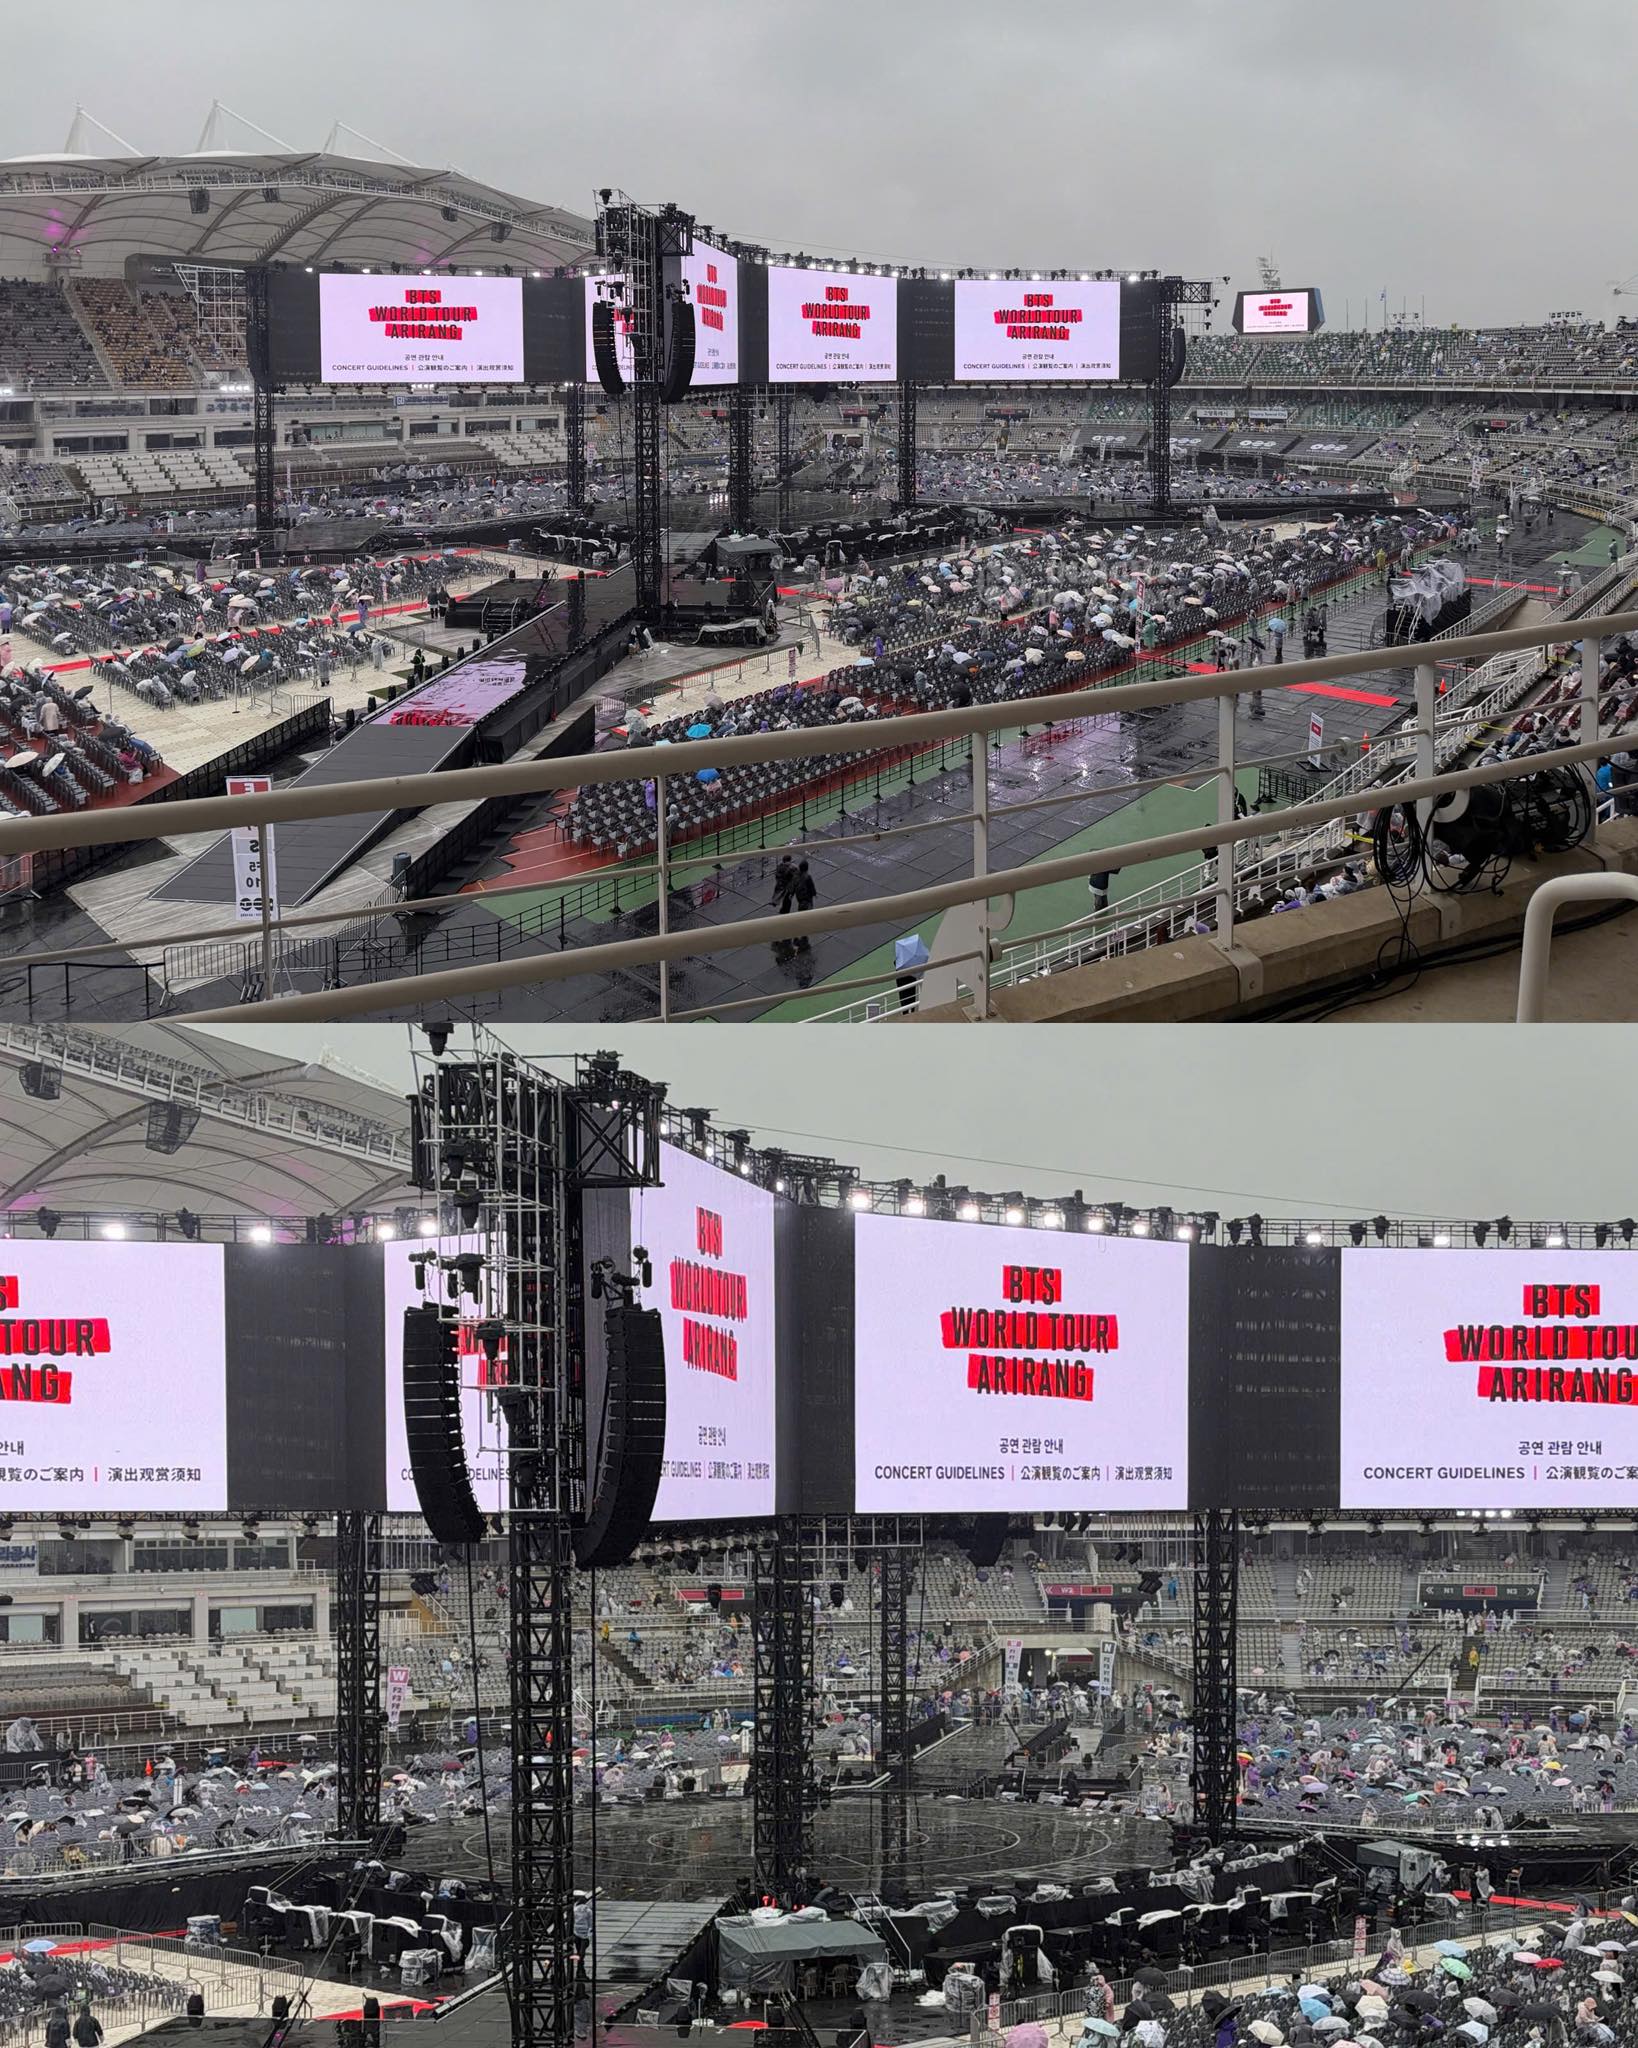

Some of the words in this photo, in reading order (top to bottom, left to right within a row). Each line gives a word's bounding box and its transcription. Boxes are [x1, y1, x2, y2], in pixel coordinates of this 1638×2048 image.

[409, 290, 437, 304] BTS
[827, 287, 846, 301] BTS
[1027, 294, 1050, 307] BTS
[374, 306, 429, 322] WORLD
[434, 306, 472, 322] TOUR
[805, 302, 840, 319] WORLD
[843, 304, 867, 320] TOUR
[999, 309, 1043, 323] WORLD
[1047, 309, 1078, 324] TOUR
[390, 323, 459, 339] ARIRANG
[816, 321, 858, 337] ARIRANG
[1011, 326, 1066, 340] ARIRANG
[698, 1206, 722, 1260] BTS
[674, 1255, 714, 1317] WORLD
[716, 1269, 745, 1324] TOUR
[1008, 1265, 1056, 1305] BTS
[1532, 1284, 1591, 1319] BTS
[0, 1318, 95, 1357] TOUR
[952, 1306, 1040, 1350] WORLD
[1047, 1312, 1109, 1354] TOUR
[687, 1322, 736, 1376] ARIRANG
[1458, 1324, 1569, 1361] WORLD
[977, 1354, 1087, 1397] ARIRANG
[1490, 1366, 1633, 1403] ARIRANG
[999, 1438, 1020, 1454] 공연
[1022, 1438, 1042, 1454] 관람
[1044, 1438, 1064, 1454] 안내
[1518, 1440, 1544, 1456] 공연
[1547, 1440, 1573, 1456] 관람
[1576, 1440, 1602, 1456] 안내
[107, 1466, 201, 1482] 演出观赏须知
[671, 1460, 702, 1478] GUIDELINES
[874, 1465, 932, 1480] CONCERT
[935, 1465, 1005, 1480] GUIDELINES
[1020, 1465, 1101, 1481] 公演観覧のご案内
[1115, 1465, 1173, 1481] 演出观赏须知
[1363, 1466, 1433, 1480] CONCERT
[1437, 1466, 1525, 1480] GUIDELINES
[1506, 1587, 1517, 1595] N3
[1104, 1643, 1112, 1652] N
[392, 1671, 406, 1681] W
